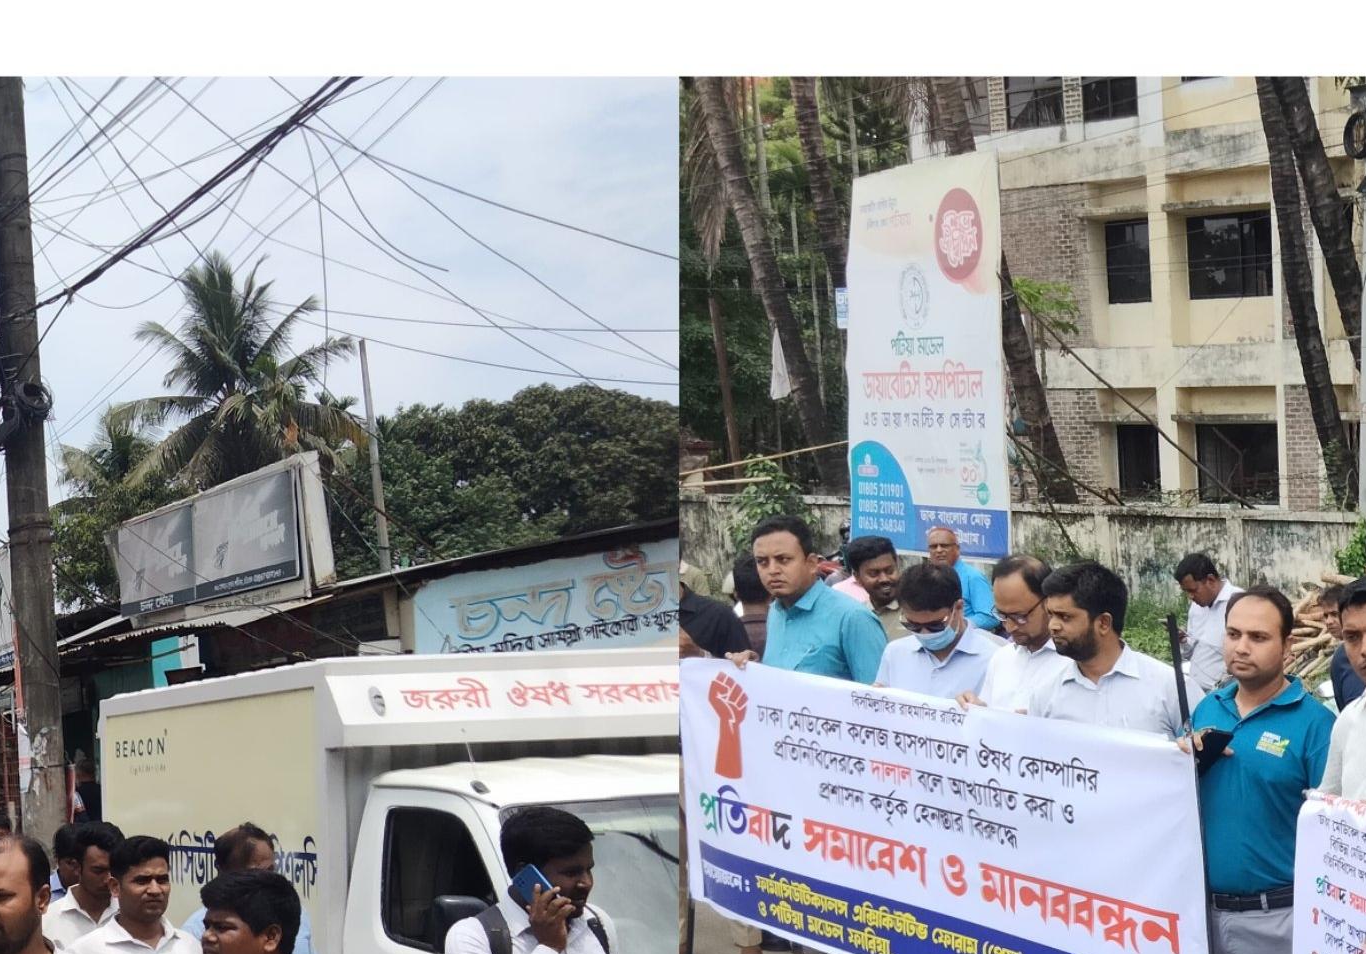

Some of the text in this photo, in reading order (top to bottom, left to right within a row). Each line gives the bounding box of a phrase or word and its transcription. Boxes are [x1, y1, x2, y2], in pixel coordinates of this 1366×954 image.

[400, 677, 491, 711] জরুরী
[506, 680, 571, 706] ঔষধ
[115, 737, 165, 758] BEACON
[756, 704, 1100, 794] ঢাকা মেডিকেল কলেজ হাসপাতালে ঔষধ কোম্পানির
[773, 734, 1075, 825] প্রতিনিধিদেরকে দালাল বলে আখ্যায়িত করা ও
[700, 784, 792, 850] প্রতিবাদ
[803, 818, 928, 889] সমাবেশ
[941, 854, 968, 896] ও
[819, 781, 1019, 849] প্রশাসন কর্তৃক বিরুদ্ধে
[758, 901, 767, 917] ও
[769, 900, 804, 930] পটিয়া
[807, 914, 844, 943] মডেল
